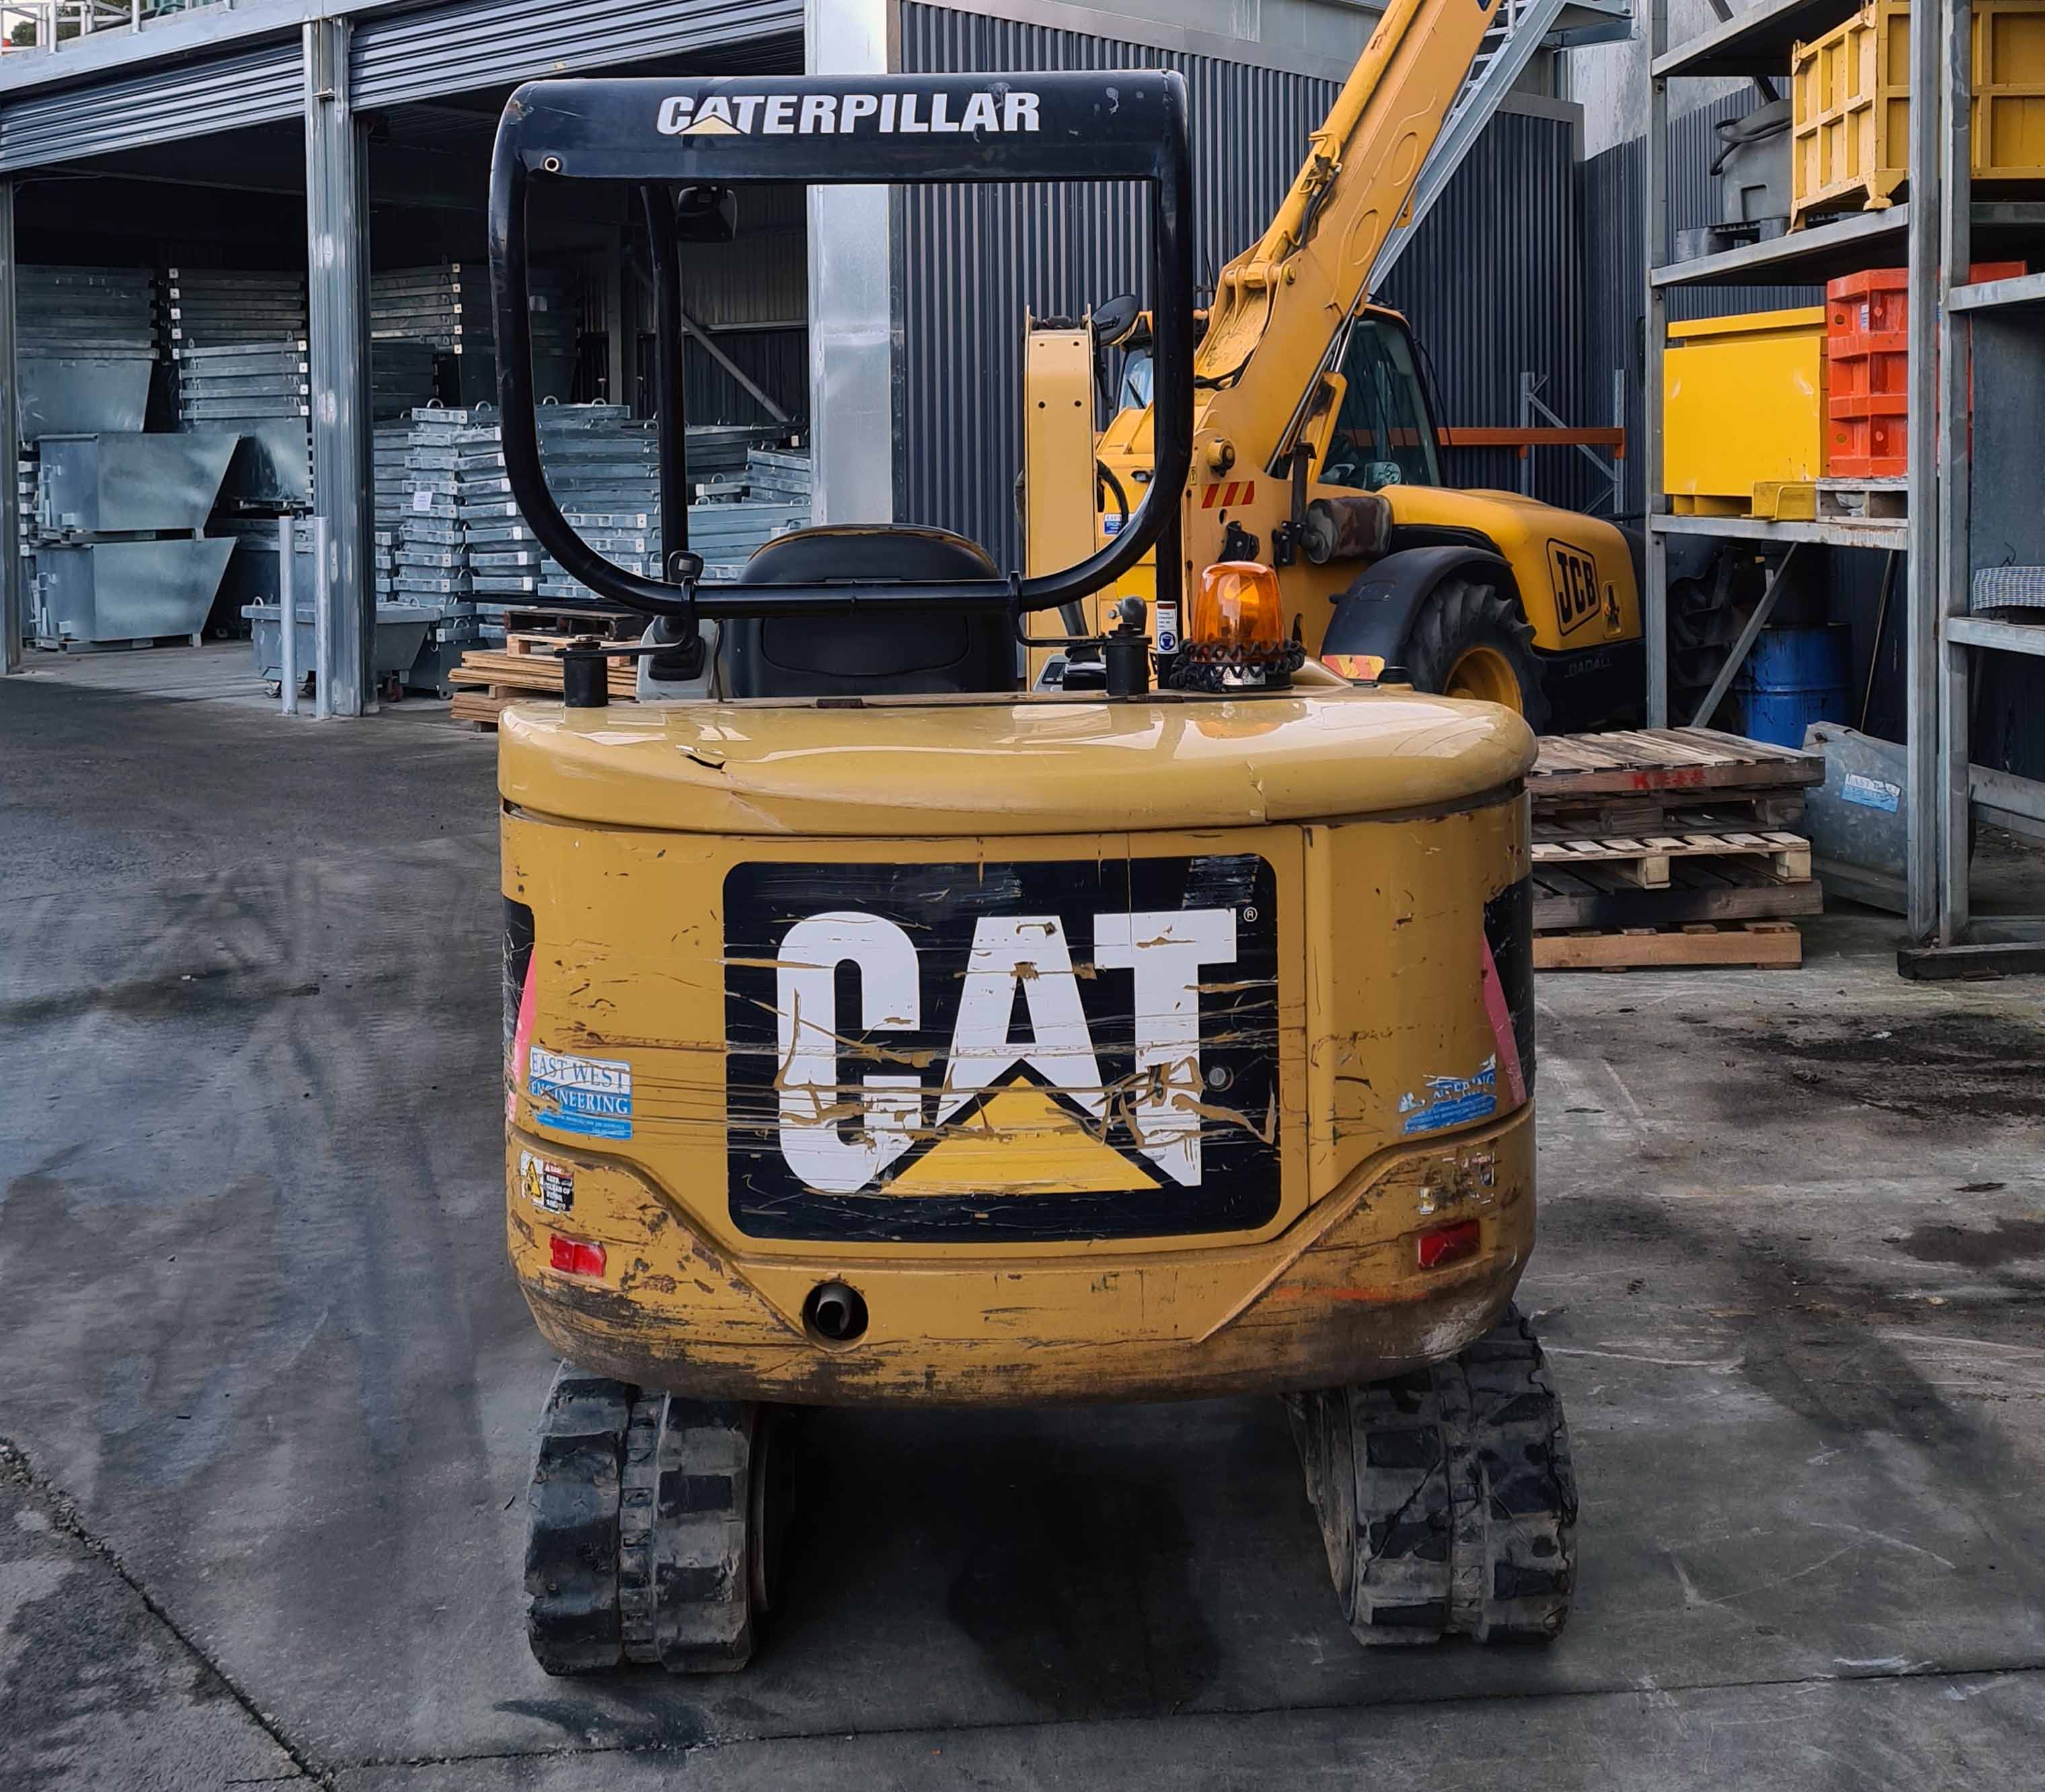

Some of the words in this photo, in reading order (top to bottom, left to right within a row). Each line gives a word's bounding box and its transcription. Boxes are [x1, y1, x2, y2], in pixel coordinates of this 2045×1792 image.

[656, 91, 1041, 135] CATERPILLAR
[1555, 550, 1597, 624] JCB
[531, 1051, 568, 1080] EAST
[573, 1062, 624, 1089] WEST
[777, 907, 1238, 1195] CAT
